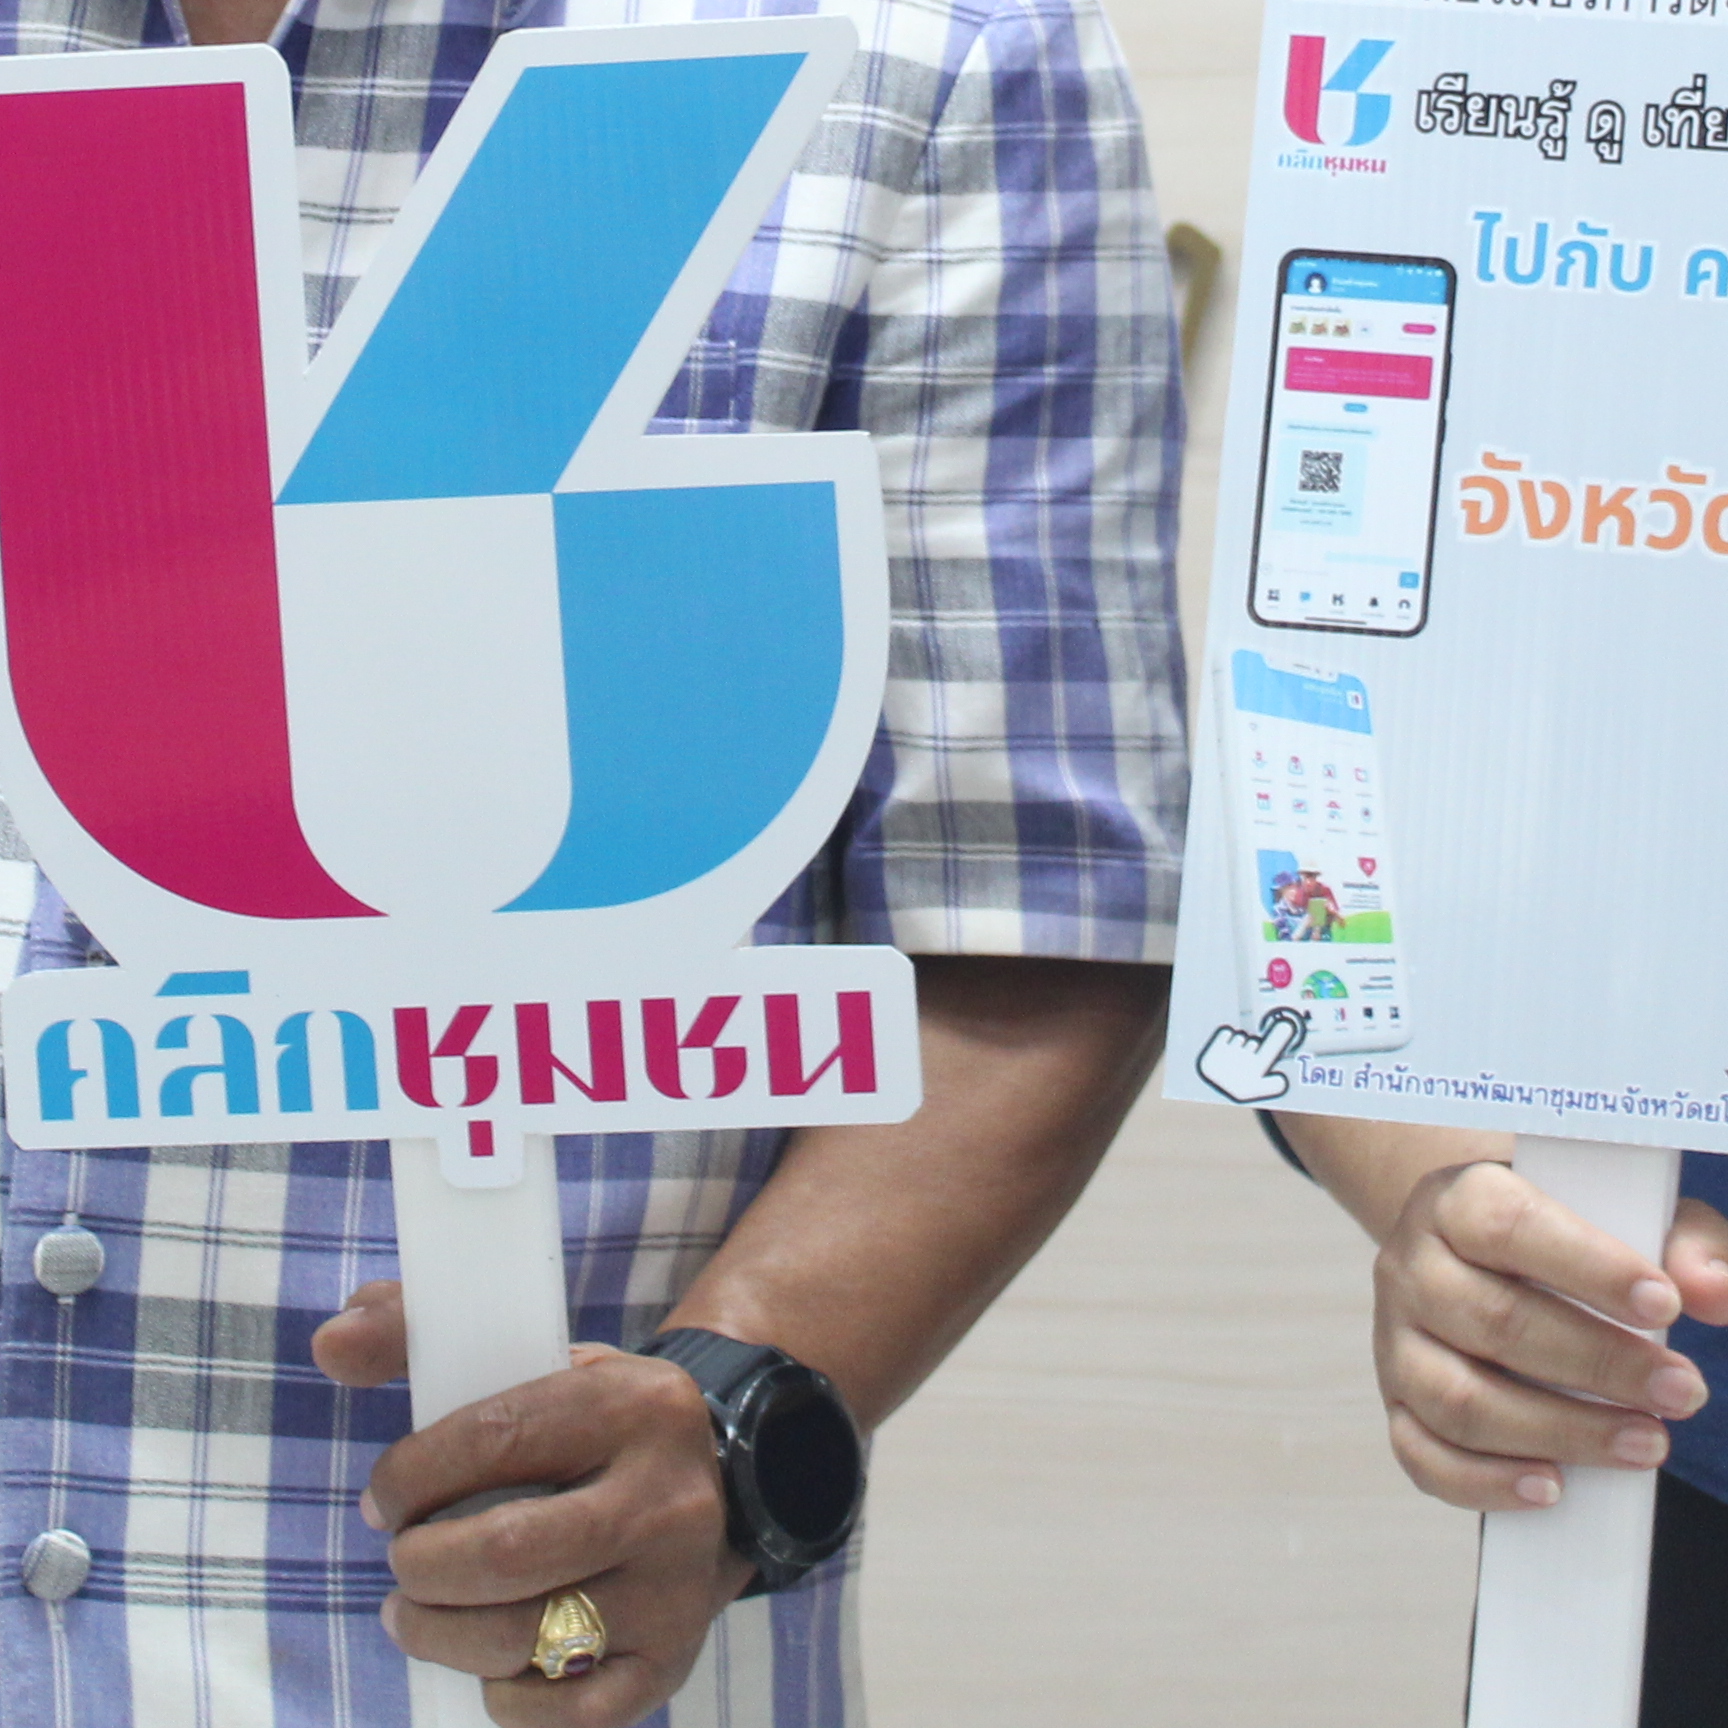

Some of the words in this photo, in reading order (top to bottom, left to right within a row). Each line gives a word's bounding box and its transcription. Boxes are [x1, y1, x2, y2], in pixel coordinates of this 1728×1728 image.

[1415, 72, 1577, 161] เรียนรู้
[1585, 99, 1627, 165] ดู
[1473, 211, 1654, 294] ไปกับ
[35, 968, 879, 1159] คลิกชุมชน
[1297, 1055, 1343, 1088] โดย
